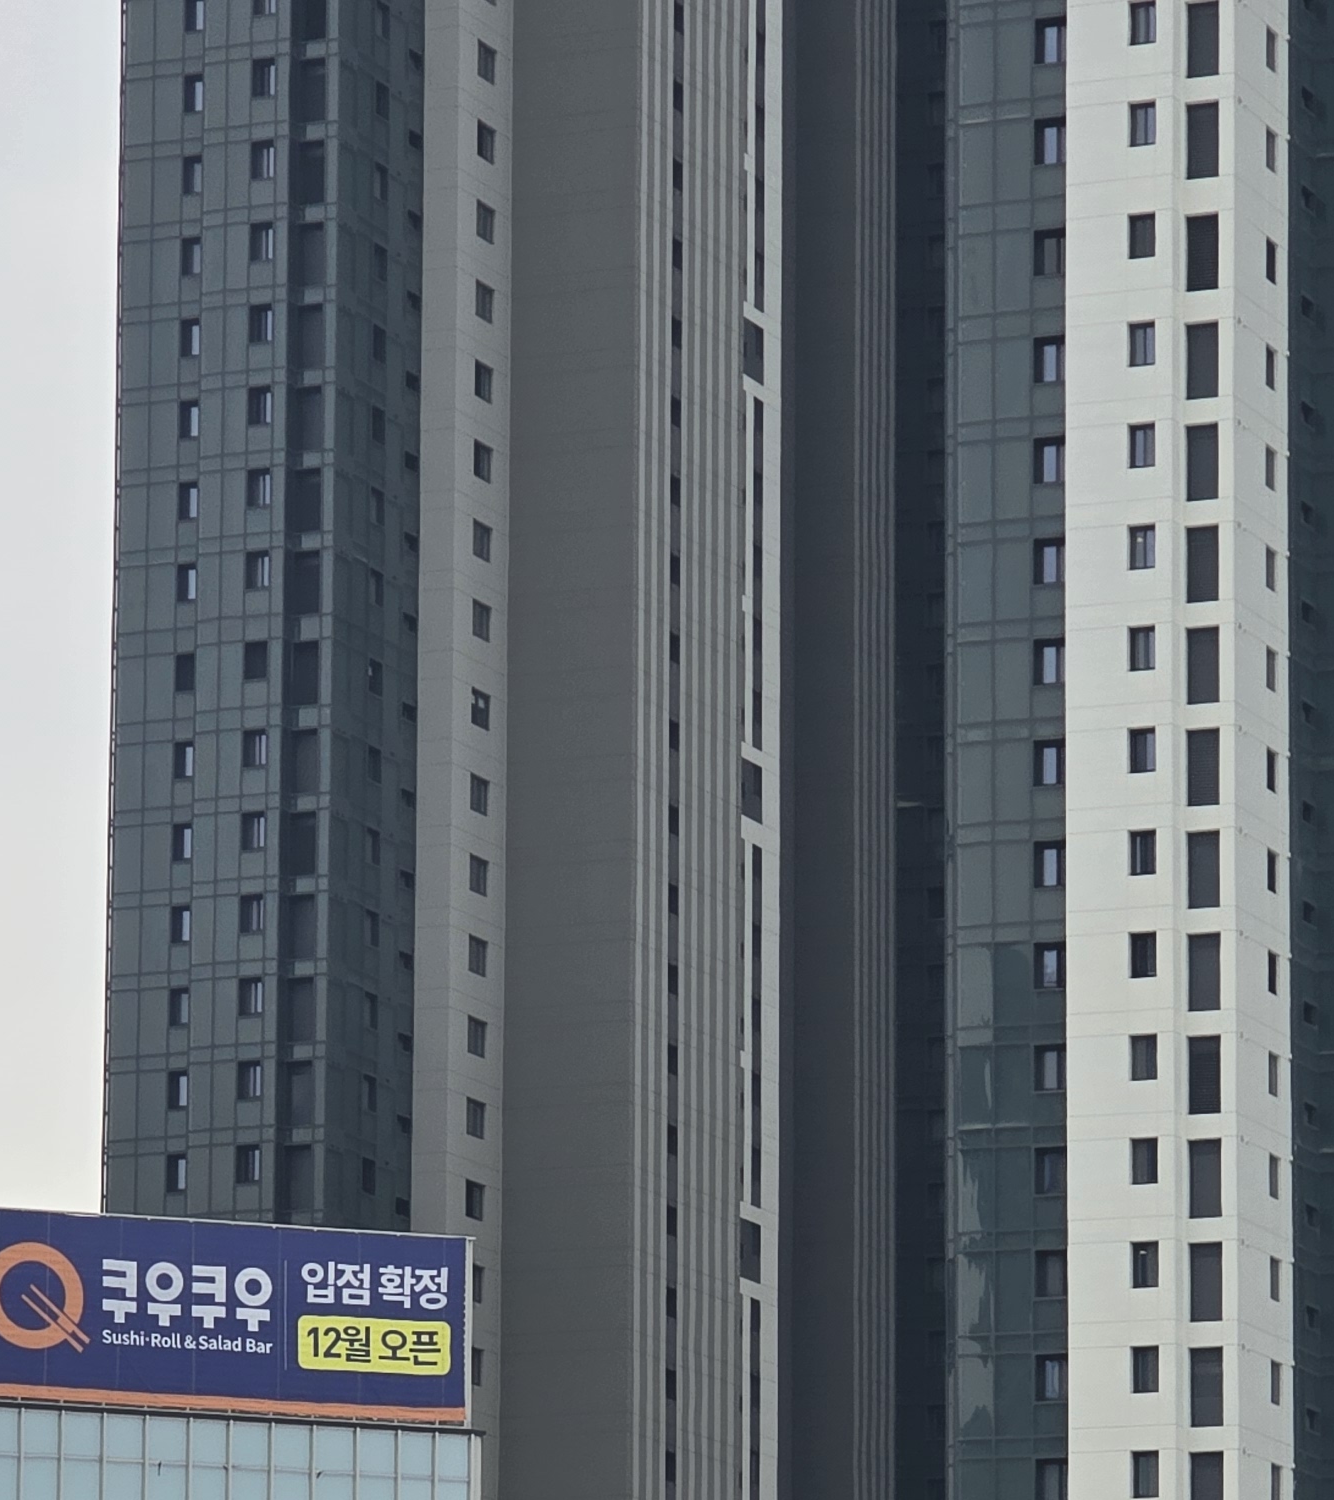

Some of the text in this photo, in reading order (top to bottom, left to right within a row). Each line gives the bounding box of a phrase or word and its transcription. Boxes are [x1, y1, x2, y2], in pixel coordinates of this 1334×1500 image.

[101, 1258, 273, 1332] 쿠우쿠우
[301, 1261, 449, 1310] 입점 확정
[184, 1335, 197, 1350] &
[198, 1334, 242, 1352] Salad
[245, 1338, 274, 1354] Bar
[307, 1325, 442, 1366] 12월 오픈
